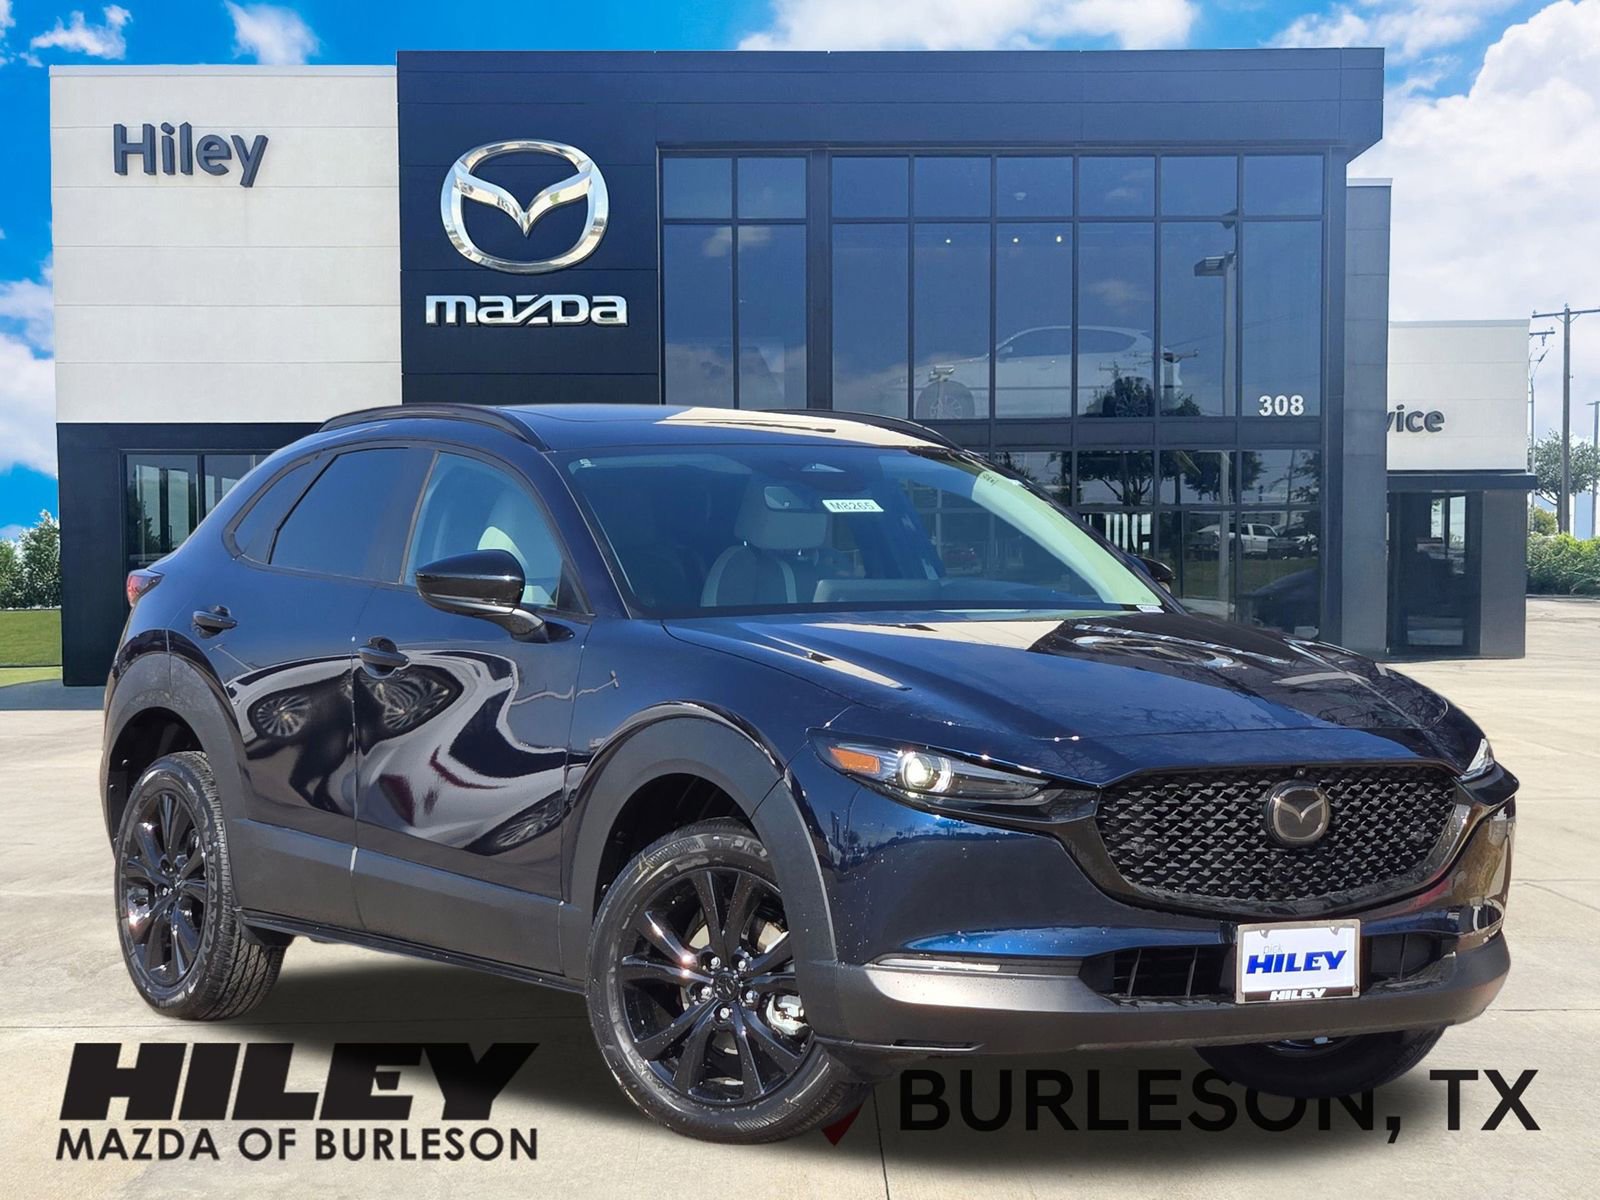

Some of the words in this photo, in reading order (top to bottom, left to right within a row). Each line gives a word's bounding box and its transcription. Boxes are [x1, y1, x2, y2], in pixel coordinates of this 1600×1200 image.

[113, 121, 269, 188] Hiley
[1258, 395, 1304, 416] 308
[828, 502, 876, 511] M8265
[1246, 950, 1347, 974] HILEY
[1270, 988, 1326, 1000] HILEY
